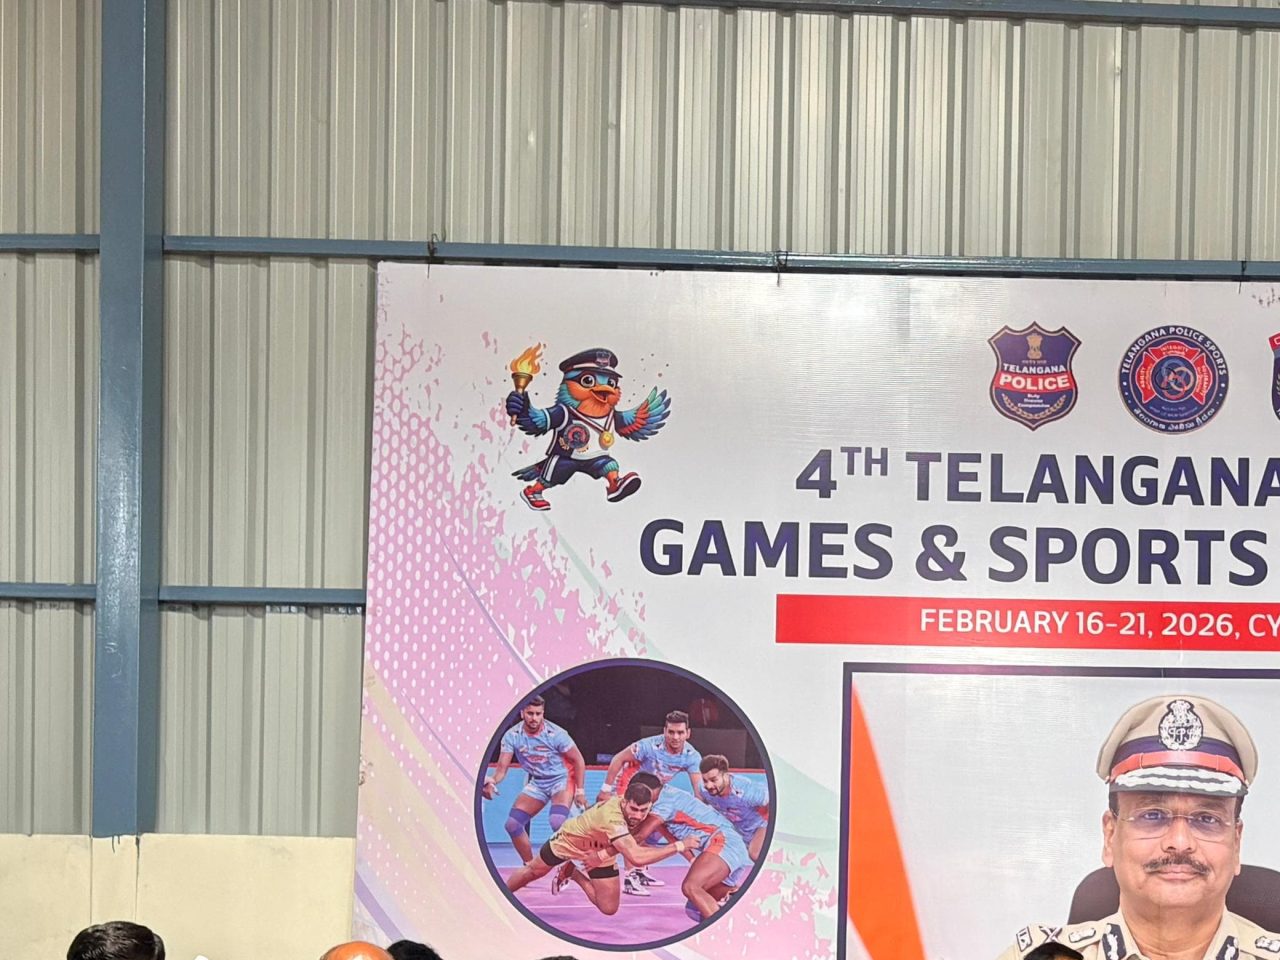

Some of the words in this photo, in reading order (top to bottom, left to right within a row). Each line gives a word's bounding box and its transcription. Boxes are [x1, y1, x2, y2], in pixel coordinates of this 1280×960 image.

[1003, 362, 1066, 374] TELANGANA
[1122, 327, 1167, 374] TELANGANA
[1169, 327, 1204, 343] POLICE
[1204, 340, 1228, 375] SPORTS
[999, 372, 1071, 391] POLICE
[796, 447, 888, 499] 4TH
[640, 518, 893, 580] GAMES
[915, 524, 968, 582] &
[988, 526, 1268, 587] SPORTS
[920, 608, 1069, 634] FEBRUARY
[1076, 611, 1154, 639] 16-21,
[1161, 612, 1241, 640] 2026,
